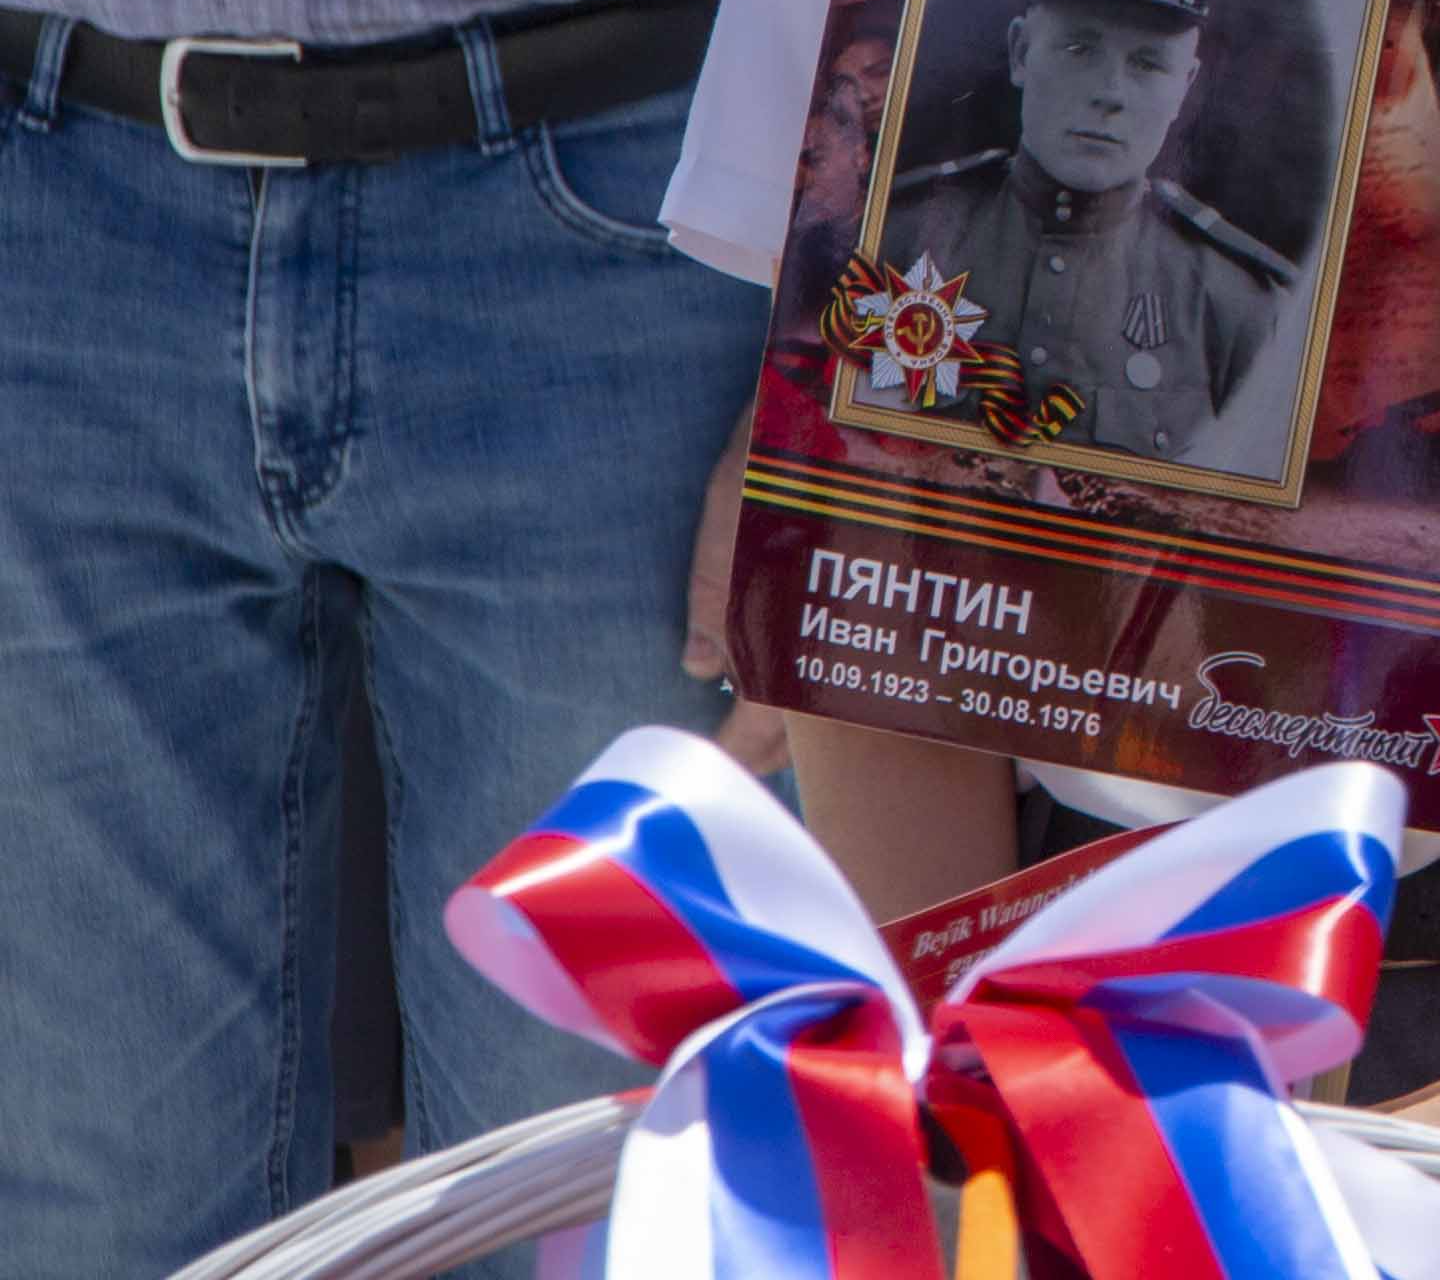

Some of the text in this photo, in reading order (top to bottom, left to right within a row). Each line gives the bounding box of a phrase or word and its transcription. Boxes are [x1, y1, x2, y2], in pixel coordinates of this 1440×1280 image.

[807, 547, 1034, 636] ПЯНТИН
[794, 654, 930, 705] 10.09.1923
[959, 687, 1102, 737] 30.08.1976
[799, 603, 1183, 711] Иван Григорьевич
